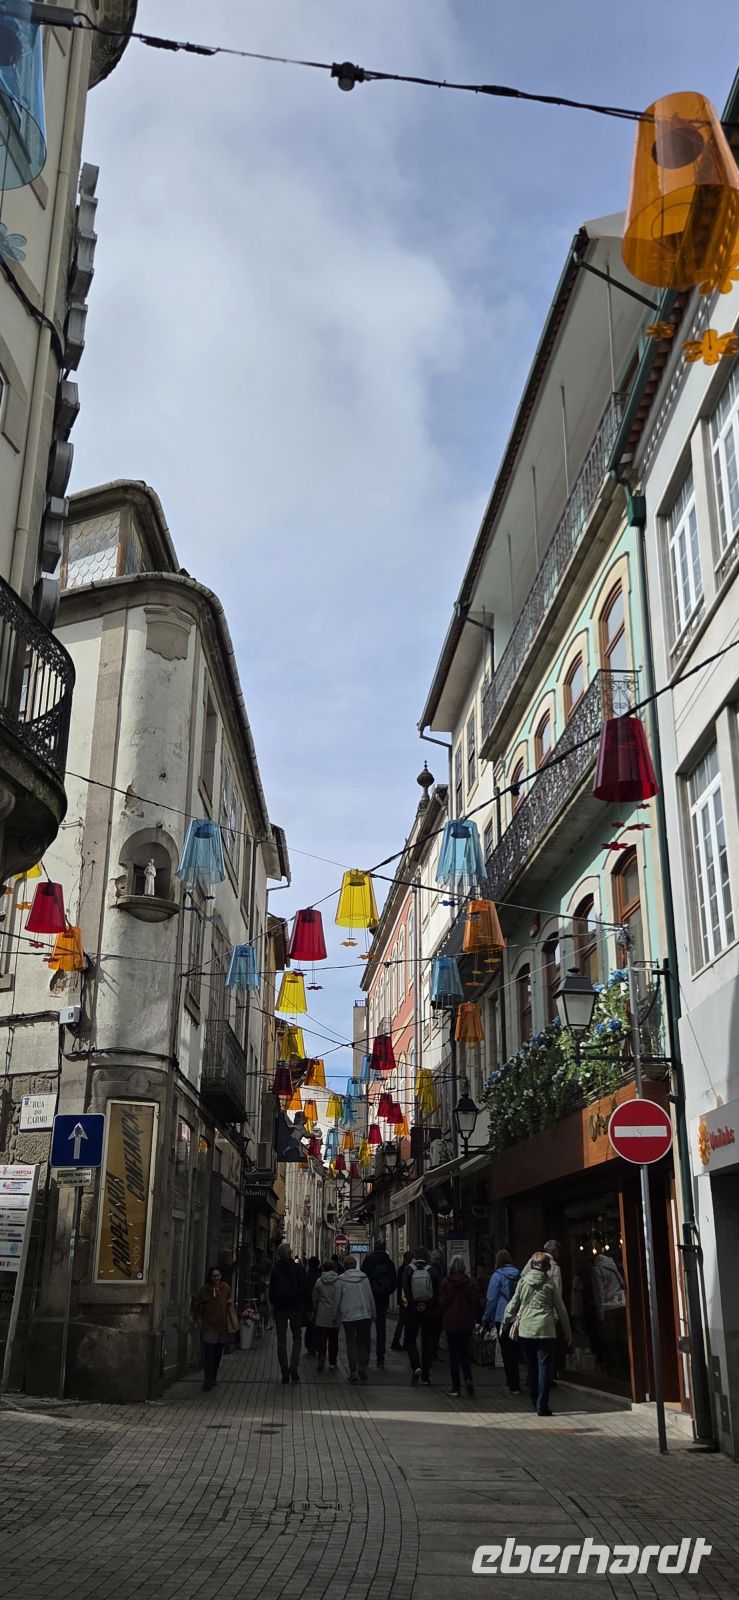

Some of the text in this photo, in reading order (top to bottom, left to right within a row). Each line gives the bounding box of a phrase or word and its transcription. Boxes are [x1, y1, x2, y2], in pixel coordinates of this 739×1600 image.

[27, 1115, 48, 1124] CARMO
[121, 1108, 145, 1202] CONFIANÇA
[106, 1171, 132, 1277] CHAPELARIA
